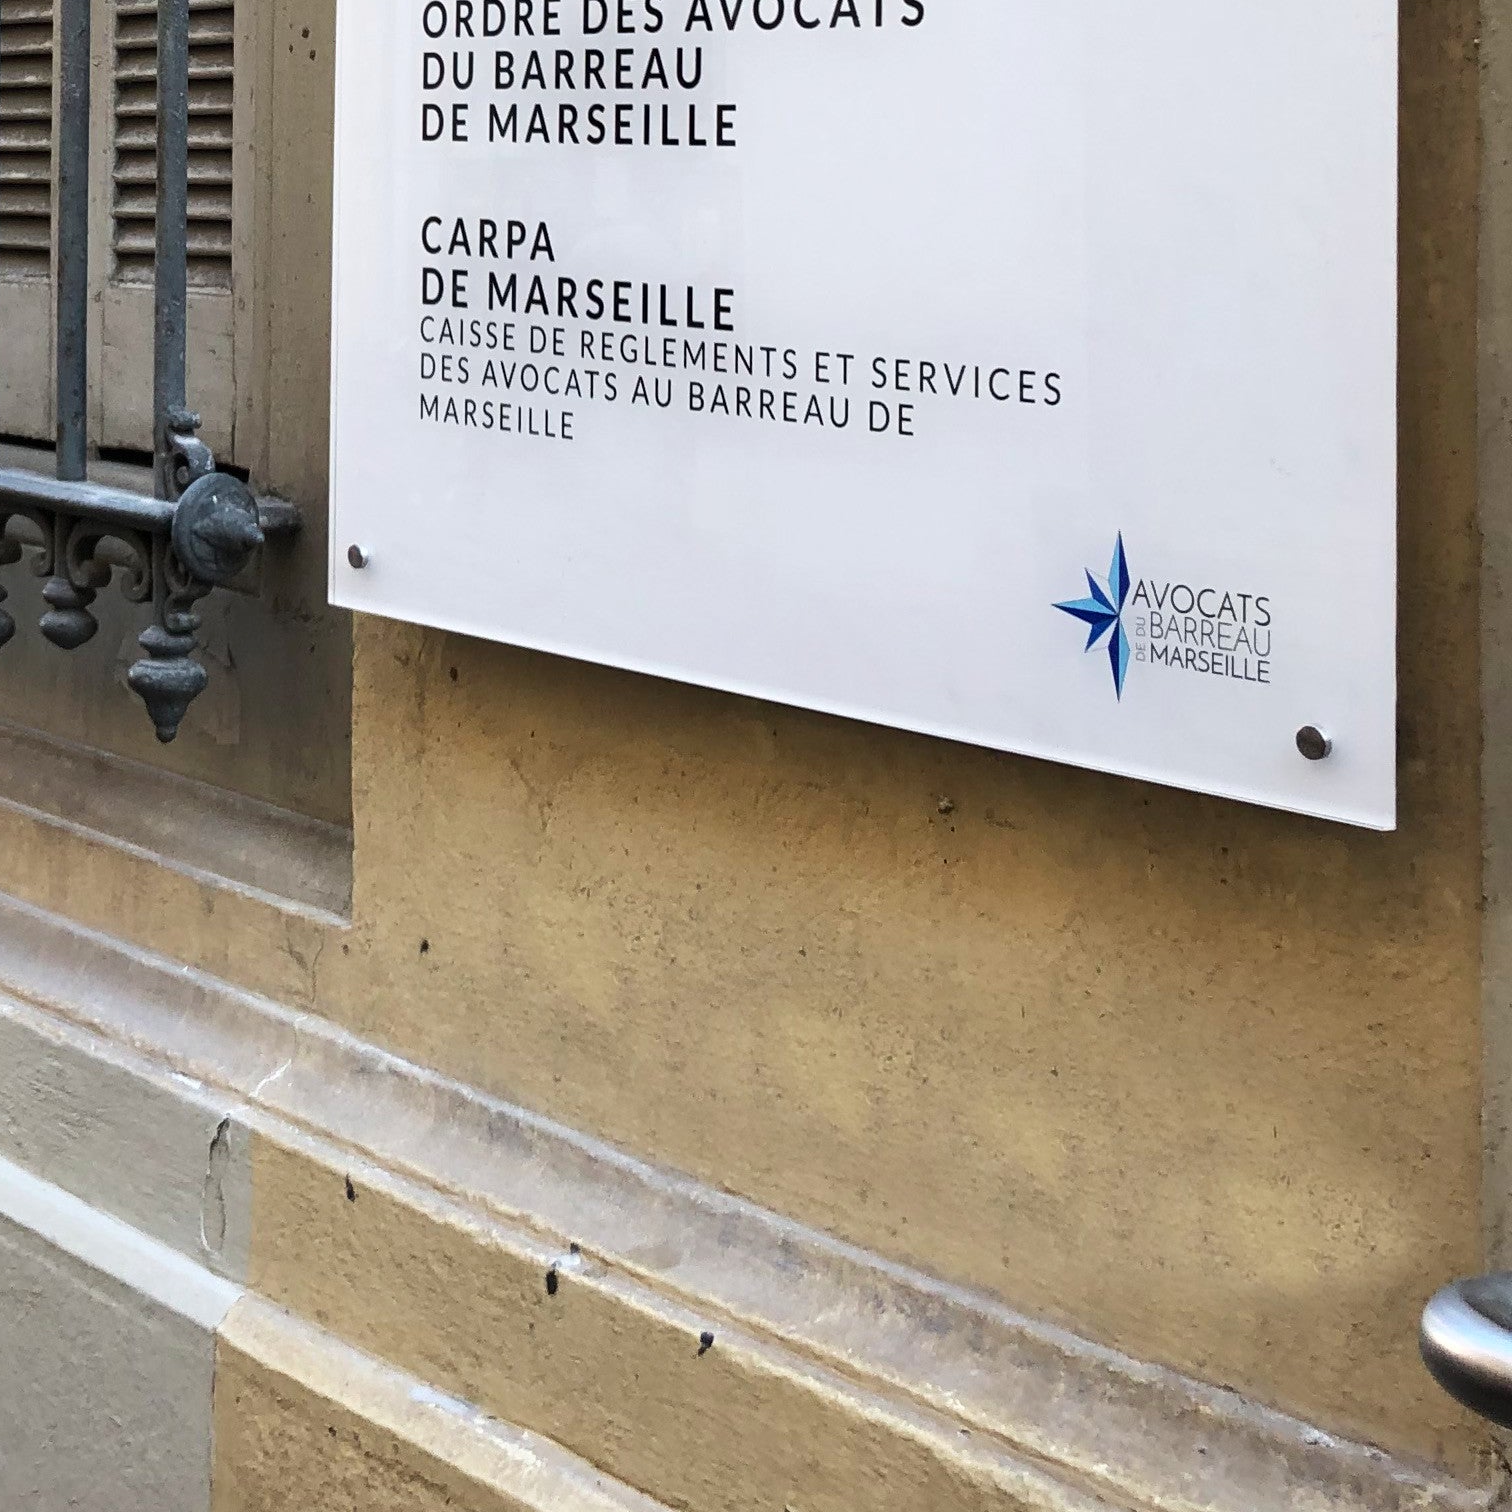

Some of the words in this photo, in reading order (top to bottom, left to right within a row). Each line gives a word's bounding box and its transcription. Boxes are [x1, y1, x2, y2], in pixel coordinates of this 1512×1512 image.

[422, 51, 475, 91] DU
[494, 46, 702, 90] BARREAU
[422, 103, 469, 142] DE
[488, 103, 737, 147] MARSEILLE
[421, 215, 555, 263] CARPA
[421, 266, 469, 309] DE
[488, 271, 735, 332] MARSEILLE
[420, 315, 516, 352] CAISSE
[530, 325, 565, 357] DE
[580, 329, 797, 380] REGLEMENTS
[815, 351, 855, 386] ET
[871, 356, 1061, 406] SERVICES
[420, 352, 469, 385] DES
[481, 359, 618, 402] AVOCATS
[631, 375, 672, 408] AU
[689, 381, 849, 429] BARREAU
[869, 400, 914, 437] DE
[420, 393, 574, 441] MARSEILLE
[1131, 578, 1271, 627] AVOCATS
[1149, 611, 1271, 657] BARREAU
[1150, 642, 1271, 684] MARSEILLE
